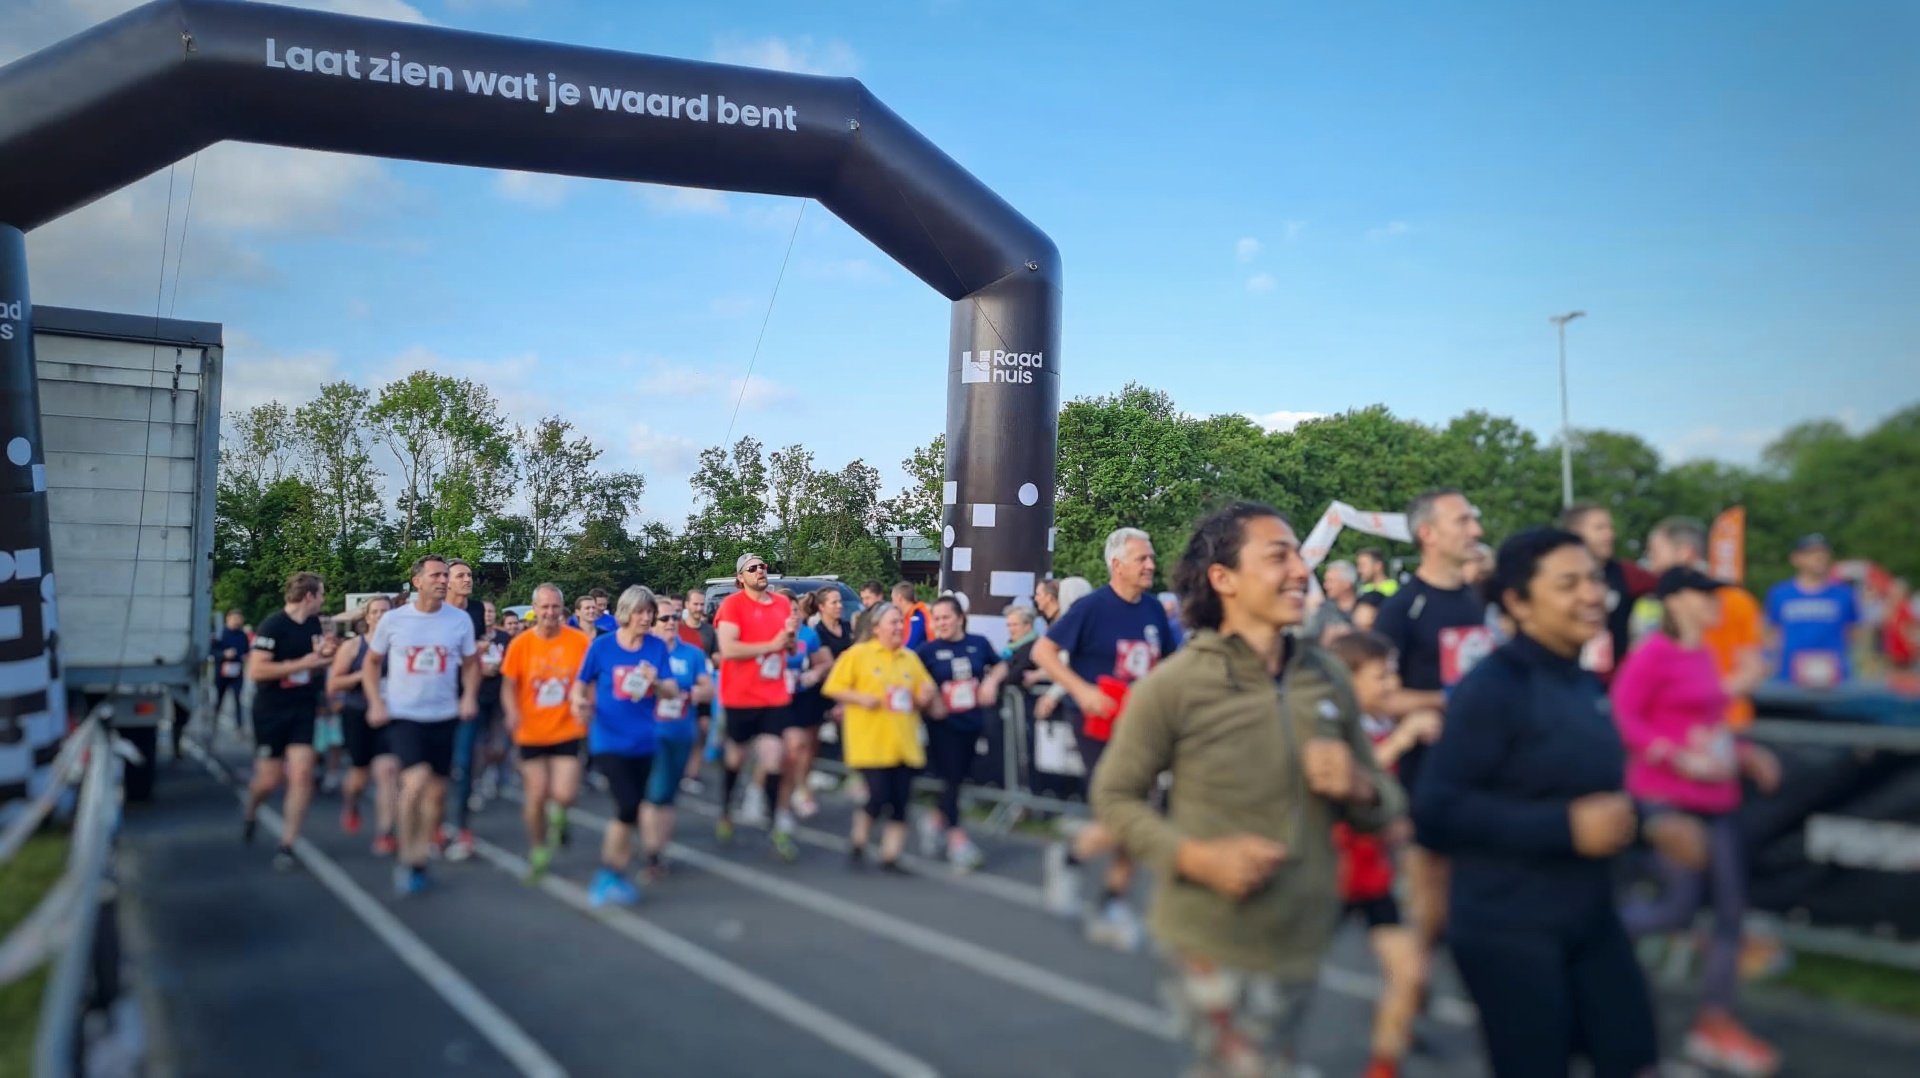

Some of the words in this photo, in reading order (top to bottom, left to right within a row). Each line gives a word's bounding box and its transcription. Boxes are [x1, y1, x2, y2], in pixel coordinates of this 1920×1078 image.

[266, 38, 361, 79] Laat
[369, 51, 453, 91] zien
[462, 69, 539, 101] wat
[545, 72, 581, 114] je
[589, 85, 709, 122] waard
[717, 95, 797, 131] bent
[993, 350, 1043, 368] Raad
[993, 366, 1033, 384] huis
